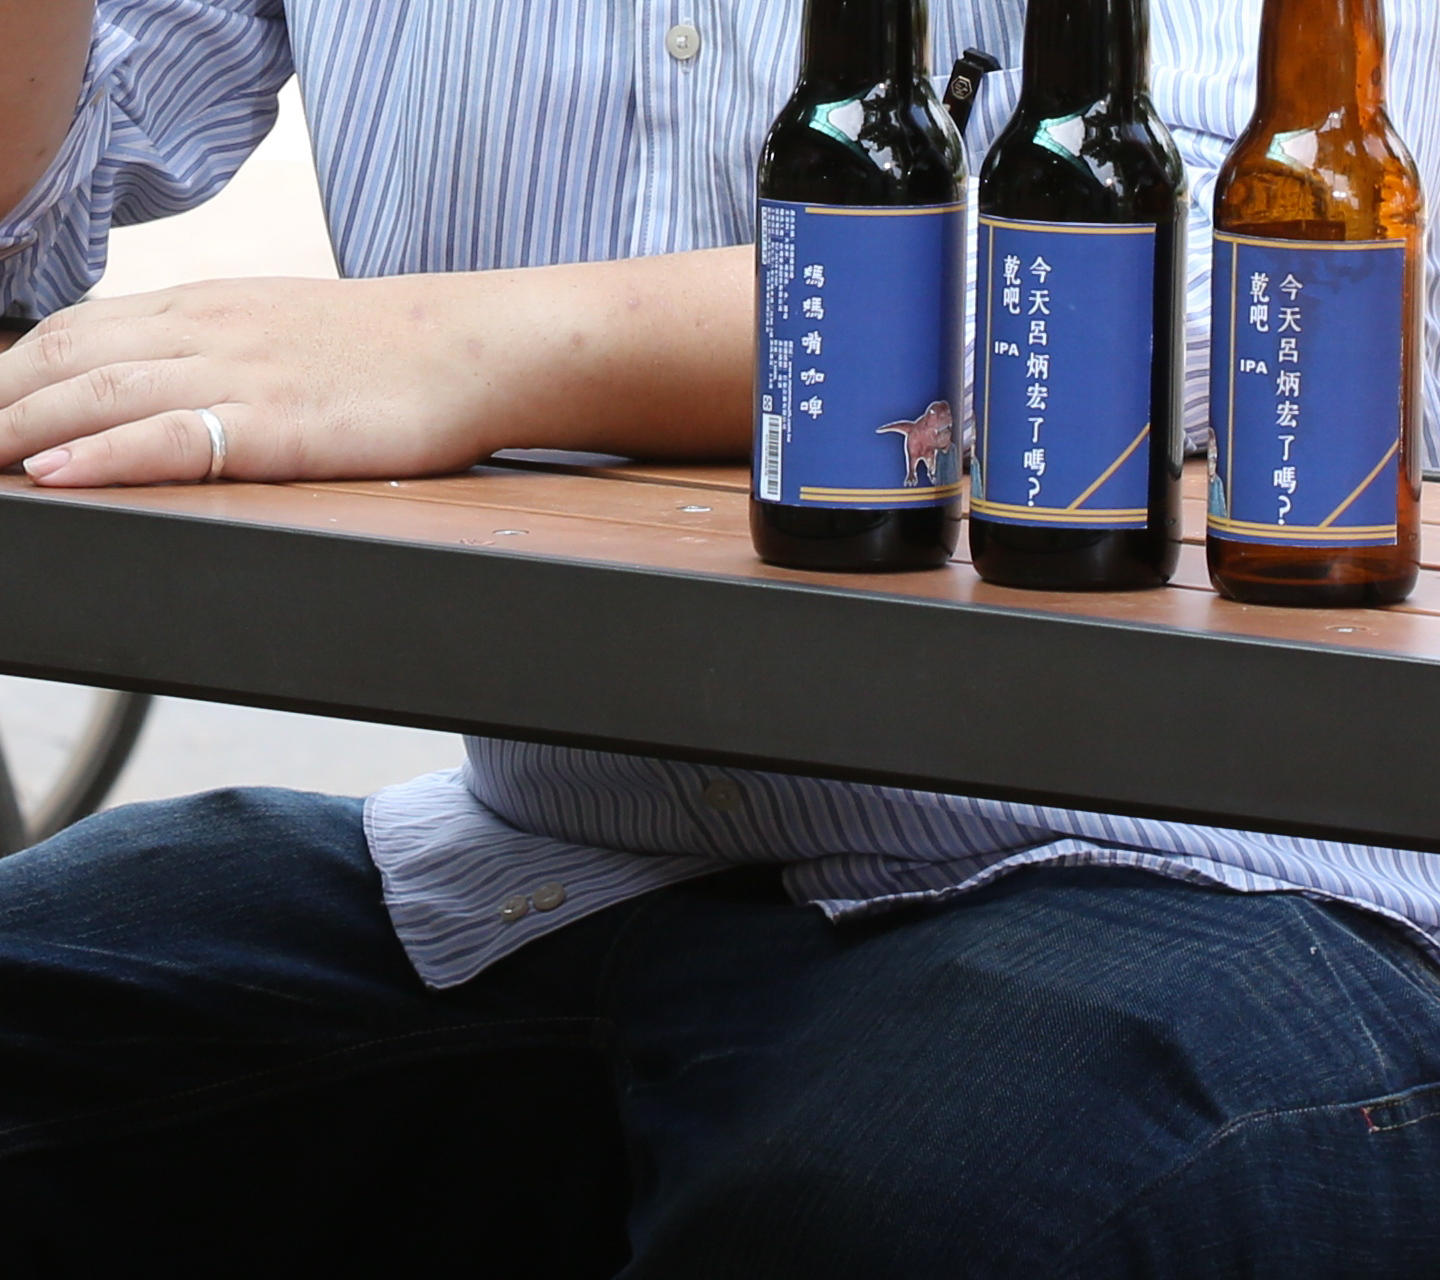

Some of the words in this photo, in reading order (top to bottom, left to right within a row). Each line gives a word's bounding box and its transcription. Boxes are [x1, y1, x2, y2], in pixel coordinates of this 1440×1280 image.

[1002, 254, 1022, 315] 乾吧
[1249, 271, 1270, 332] 乾吧
[994, 341, 1019, 357] IPA
[1240, 359, 1268, 375] IPA
[1024, 255, 1052, 507] 今天呂炳宏了嗎？
[1273, 273, 1304, 525] 今天呂炳宏了嗎？
